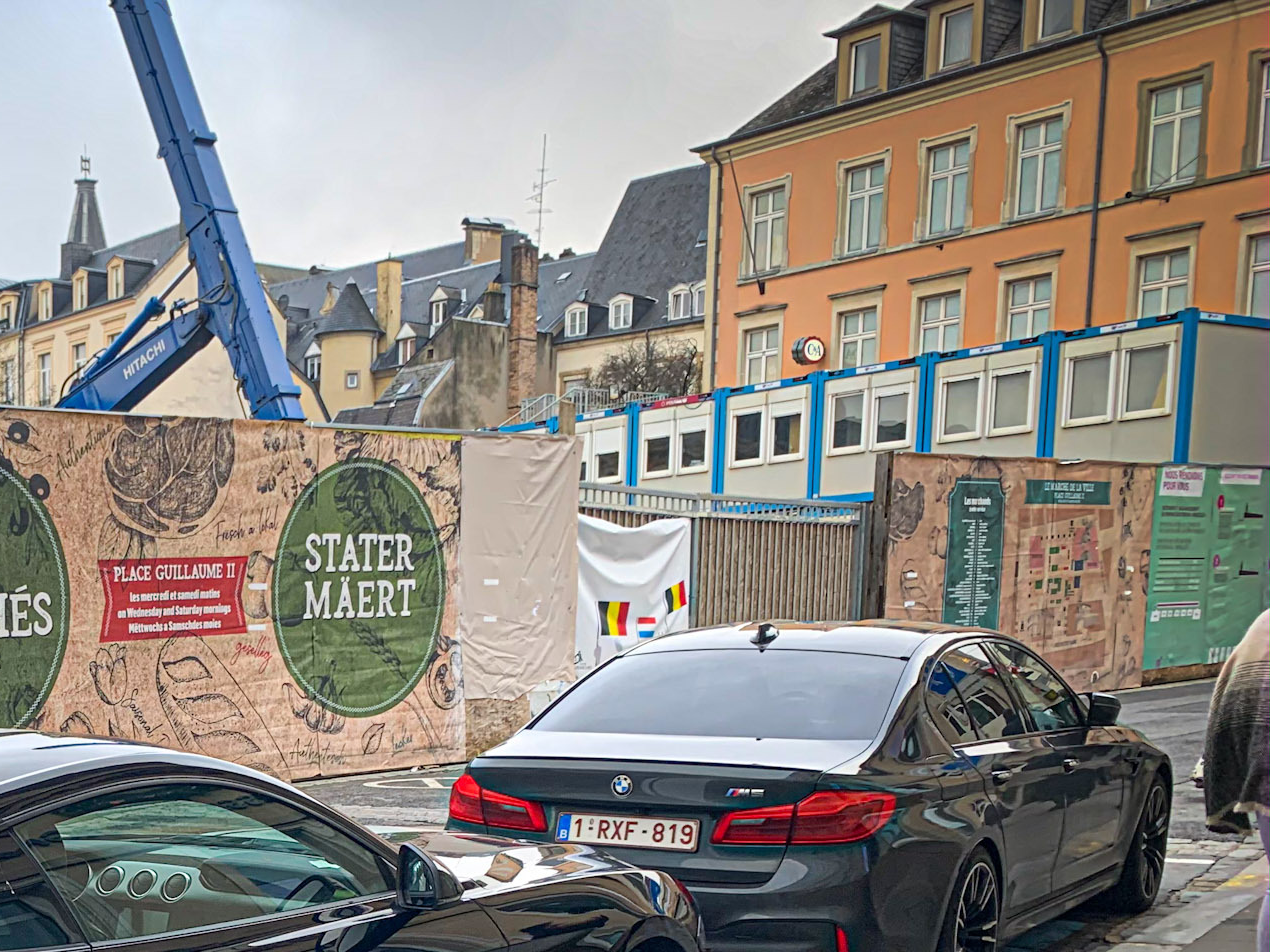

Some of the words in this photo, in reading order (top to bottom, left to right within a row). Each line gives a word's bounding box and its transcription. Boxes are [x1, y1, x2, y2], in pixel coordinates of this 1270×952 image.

[122, 339, 166, 380] HITACHI
[305, 533, 415, 573] STATER
[113, 565, 151, 582] PLACE
[155, 563, 223, 580] GUILLAUME
[226, 563, 236, 578] II
[303, 576, 417, 620] MÄERT
[126, 606, 163, 618] Wednesday
[175, 605, 202, 616] Saturday
[733, 788, 766, 798] M5
[559, 829, 568, 840] B
